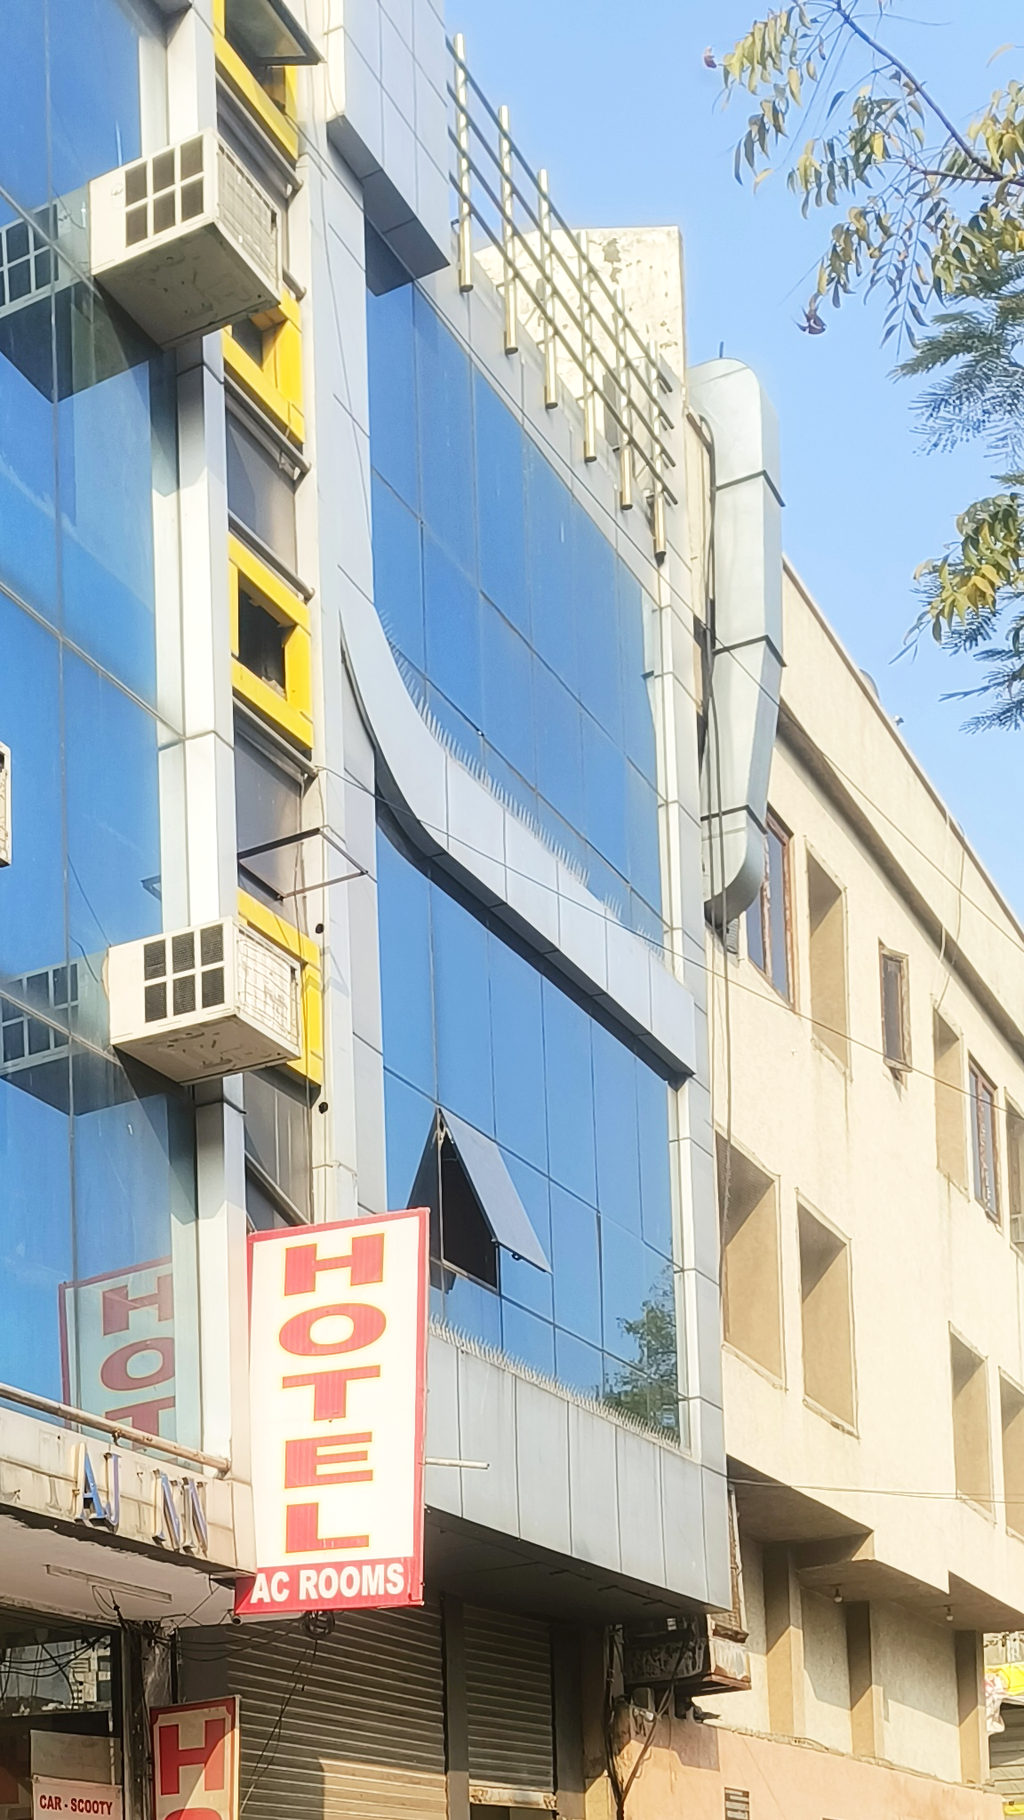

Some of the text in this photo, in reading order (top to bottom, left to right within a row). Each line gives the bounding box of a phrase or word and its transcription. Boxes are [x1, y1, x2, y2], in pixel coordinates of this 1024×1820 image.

[279, 1233, 387, 1554] HOTEL
[250, 1562, 405, 1604] AC ROOMS
[39, 1794, 62, 1811] CAR
[70, 1798, 113, 1815] SCOOTY
